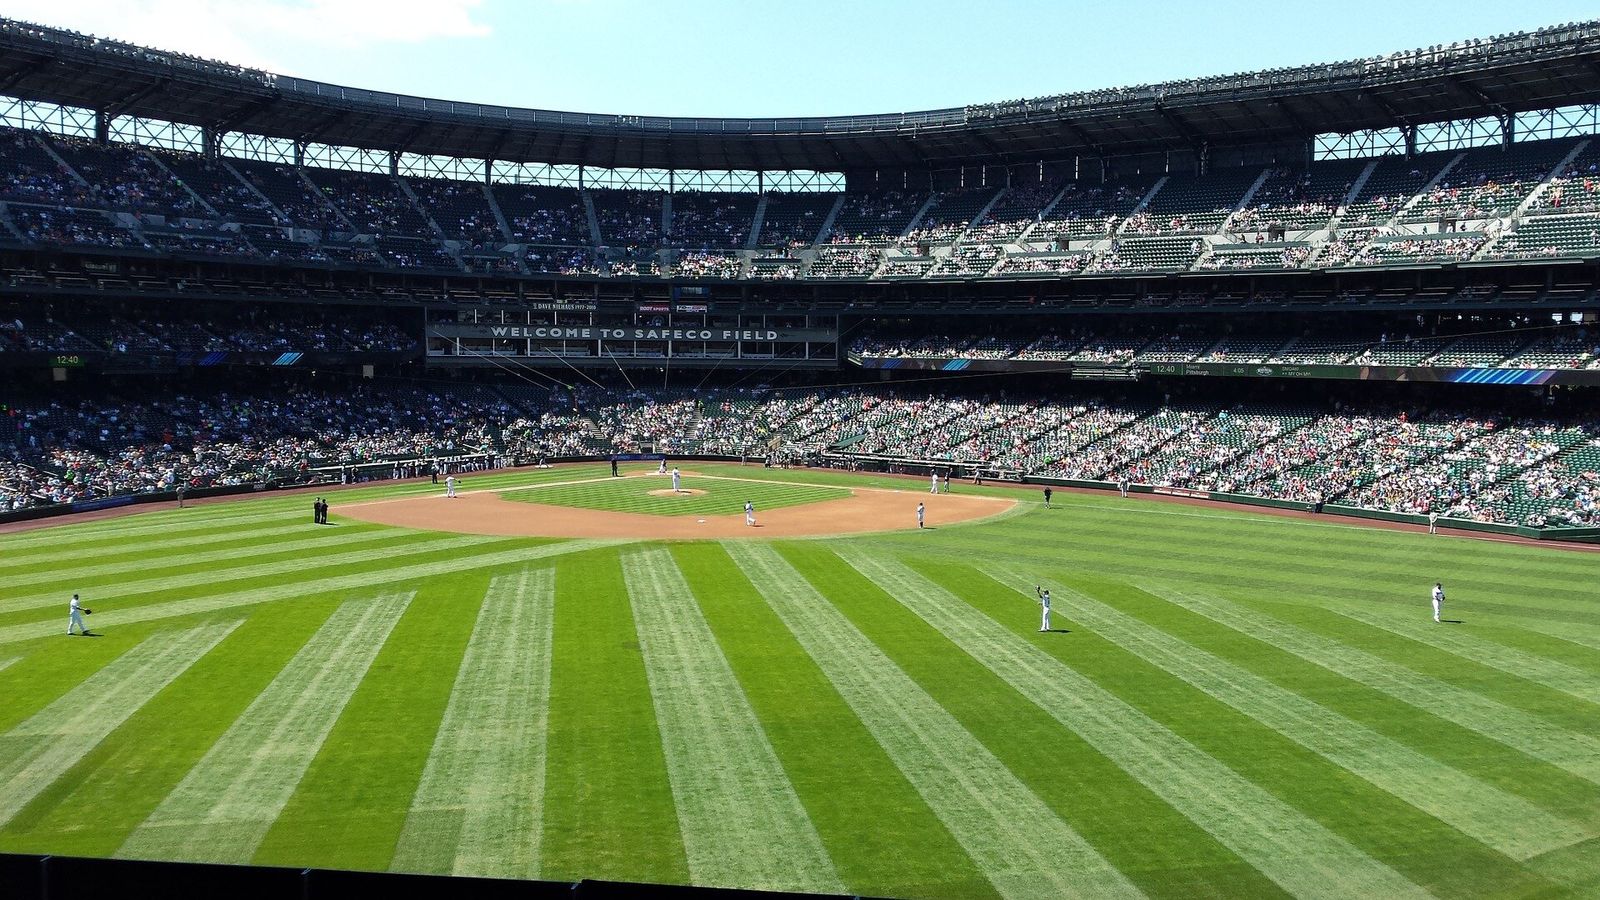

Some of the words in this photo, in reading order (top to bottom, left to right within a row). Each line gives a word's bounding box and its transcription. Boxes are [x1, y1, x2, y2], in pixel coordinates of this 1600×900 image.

[490, 326, 592, 338] WELCOME
[599, 328, 626, 338] TO
[634, 329, 713, 340] SAFECO
[722, 330, 779, 340] FIELD
[56, 355, 79, 364] 12:40
[1156, 365, 1176, 373] 12:40
